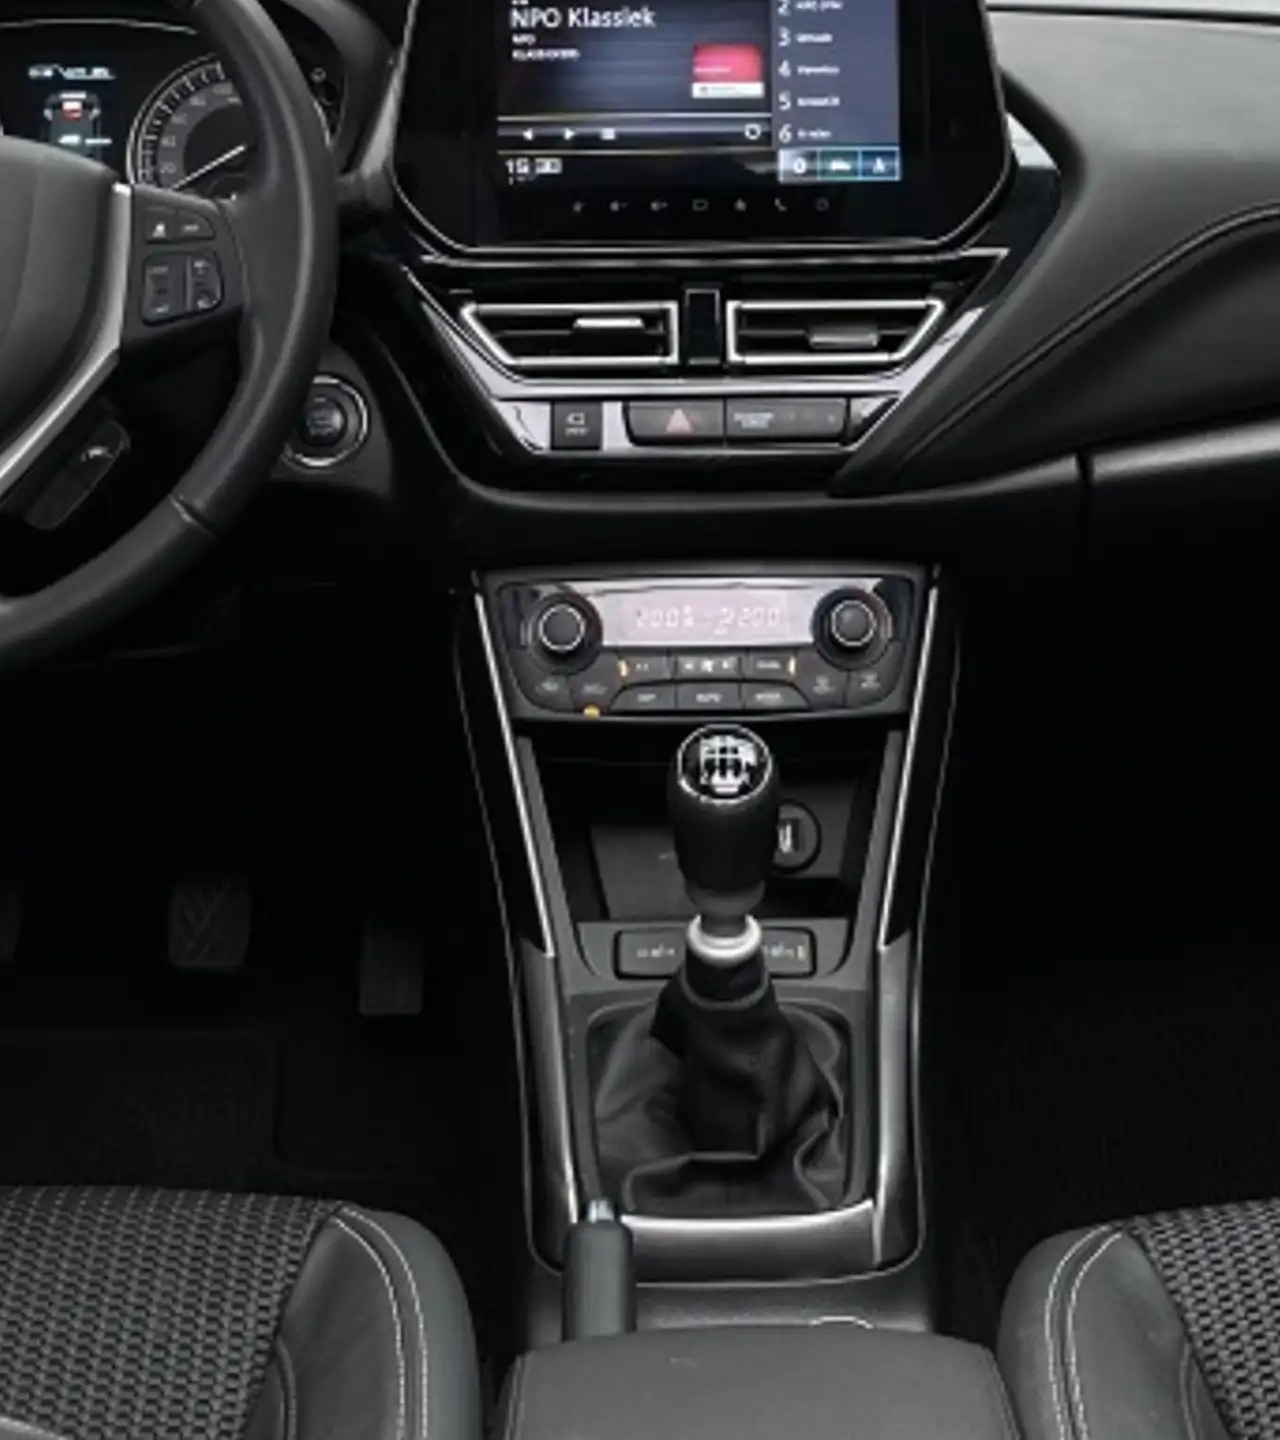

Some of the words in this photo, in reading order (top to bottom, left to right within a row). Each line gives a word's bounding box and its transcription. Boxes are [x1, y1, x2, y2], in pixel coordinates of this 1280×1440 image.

[510, 7, 563, 29] NPO
[567, 6, 657, 29] Klassiek
[778, 27, 791, 47] 3
[778, 91, 792, 110] 5
[778, 124, 793, 144] 6
